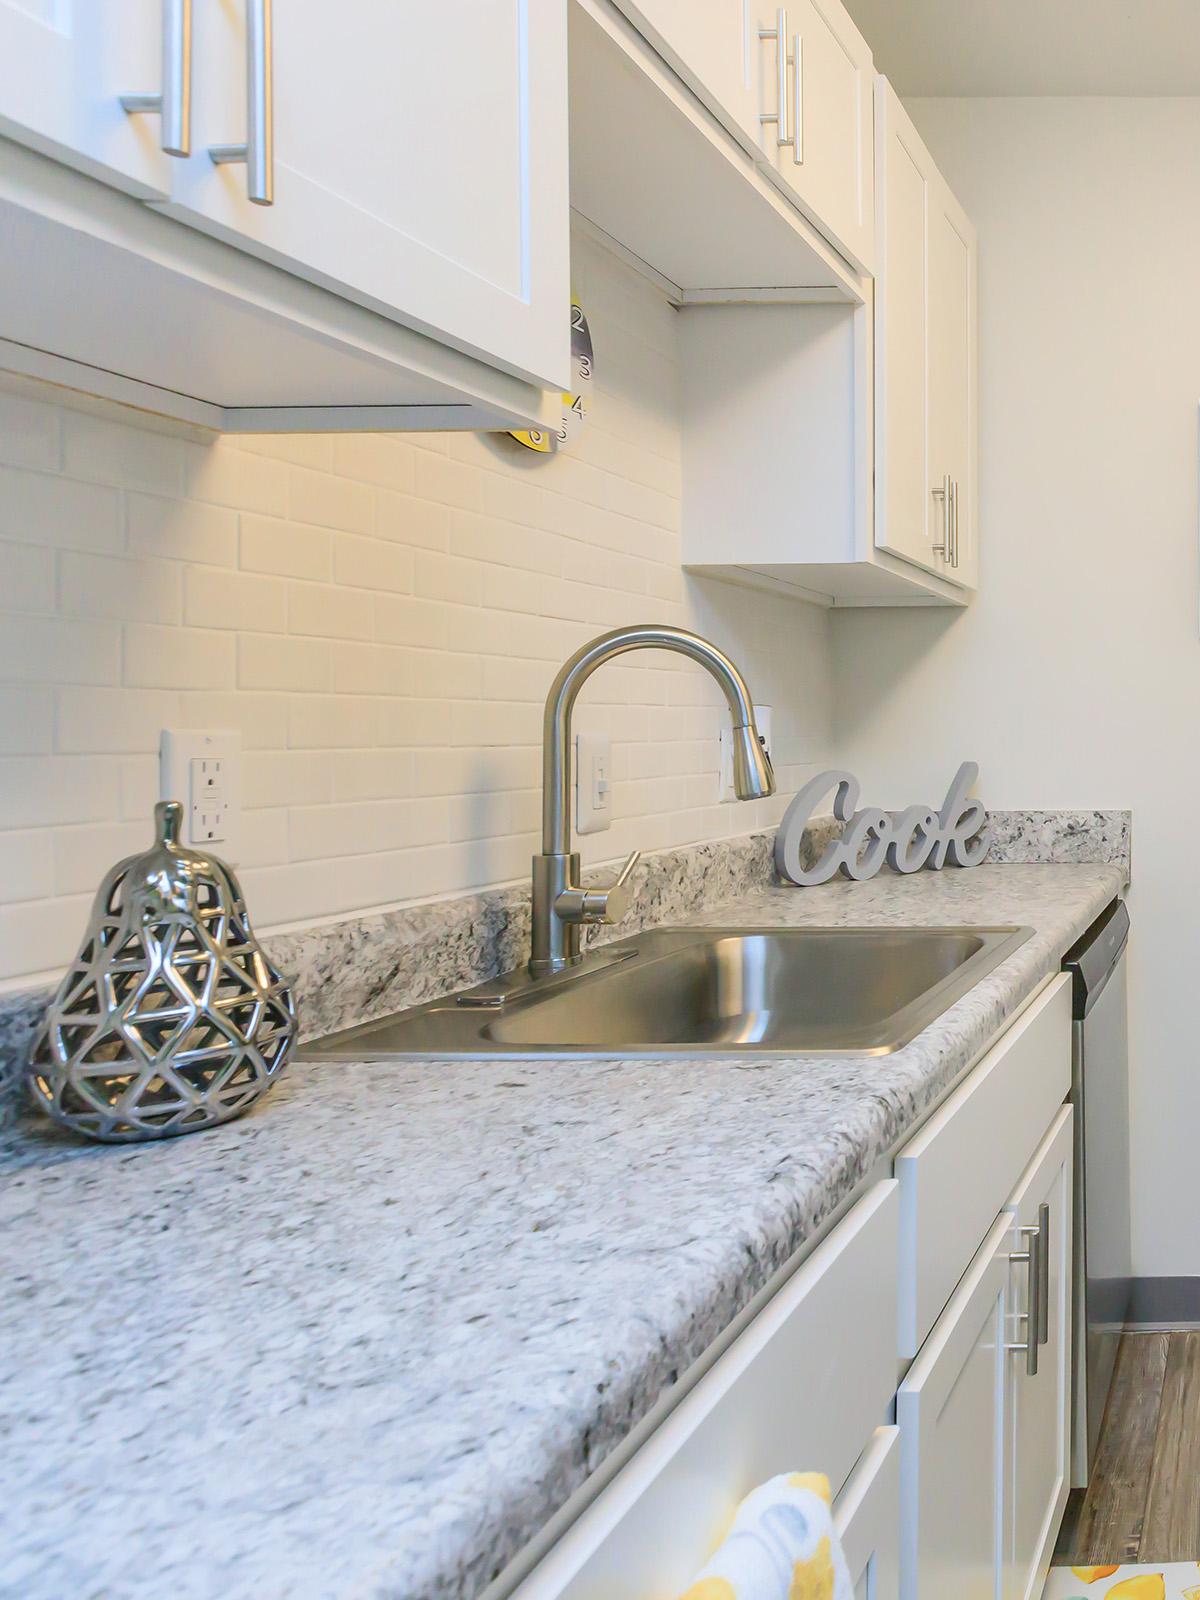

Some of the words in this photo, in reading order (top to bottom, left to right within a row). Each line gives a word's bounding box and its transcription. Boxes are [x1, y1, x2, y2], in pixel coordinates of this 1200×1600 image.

[571, 304, 585, 333] 2
[579, 353, 592, 380] 3
[571, 394, 587, 420] 4
[774, 761, 992, 887] Cook
